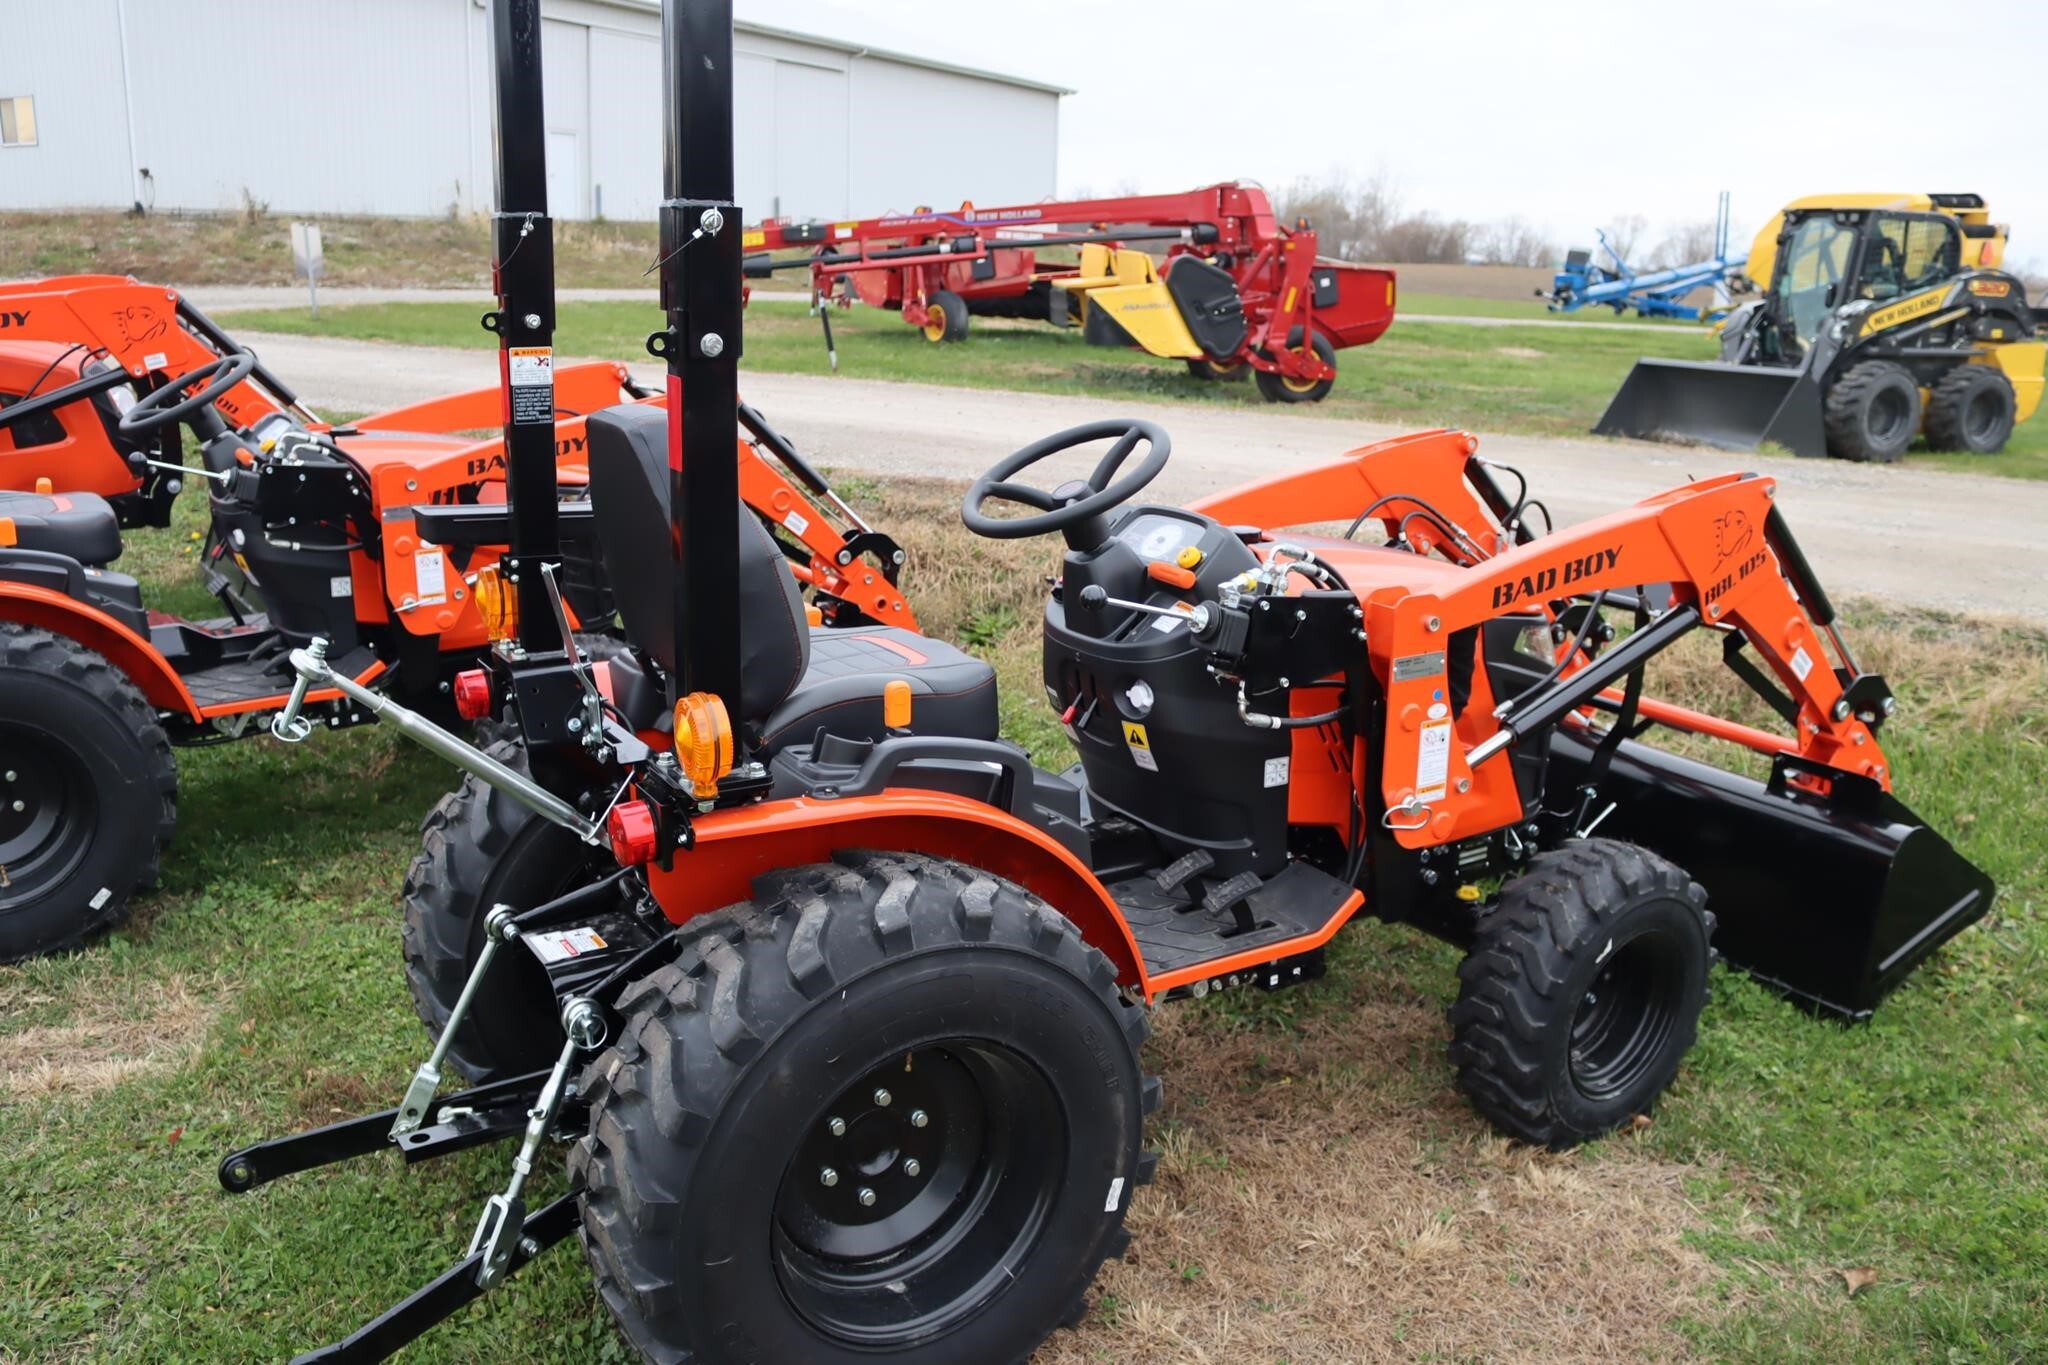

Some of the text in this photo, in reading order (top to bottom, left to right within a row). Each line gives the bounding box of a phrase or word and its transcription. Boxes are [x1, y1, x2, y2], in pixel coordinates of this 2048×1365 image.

[1873, 295, 1940, 324] NEW HOLLAND
[467, 454, 507, 476] BA
[1492, 544, 1623, 609] BAD BOY
[1705, 547, 1766, 607] BBL 105
